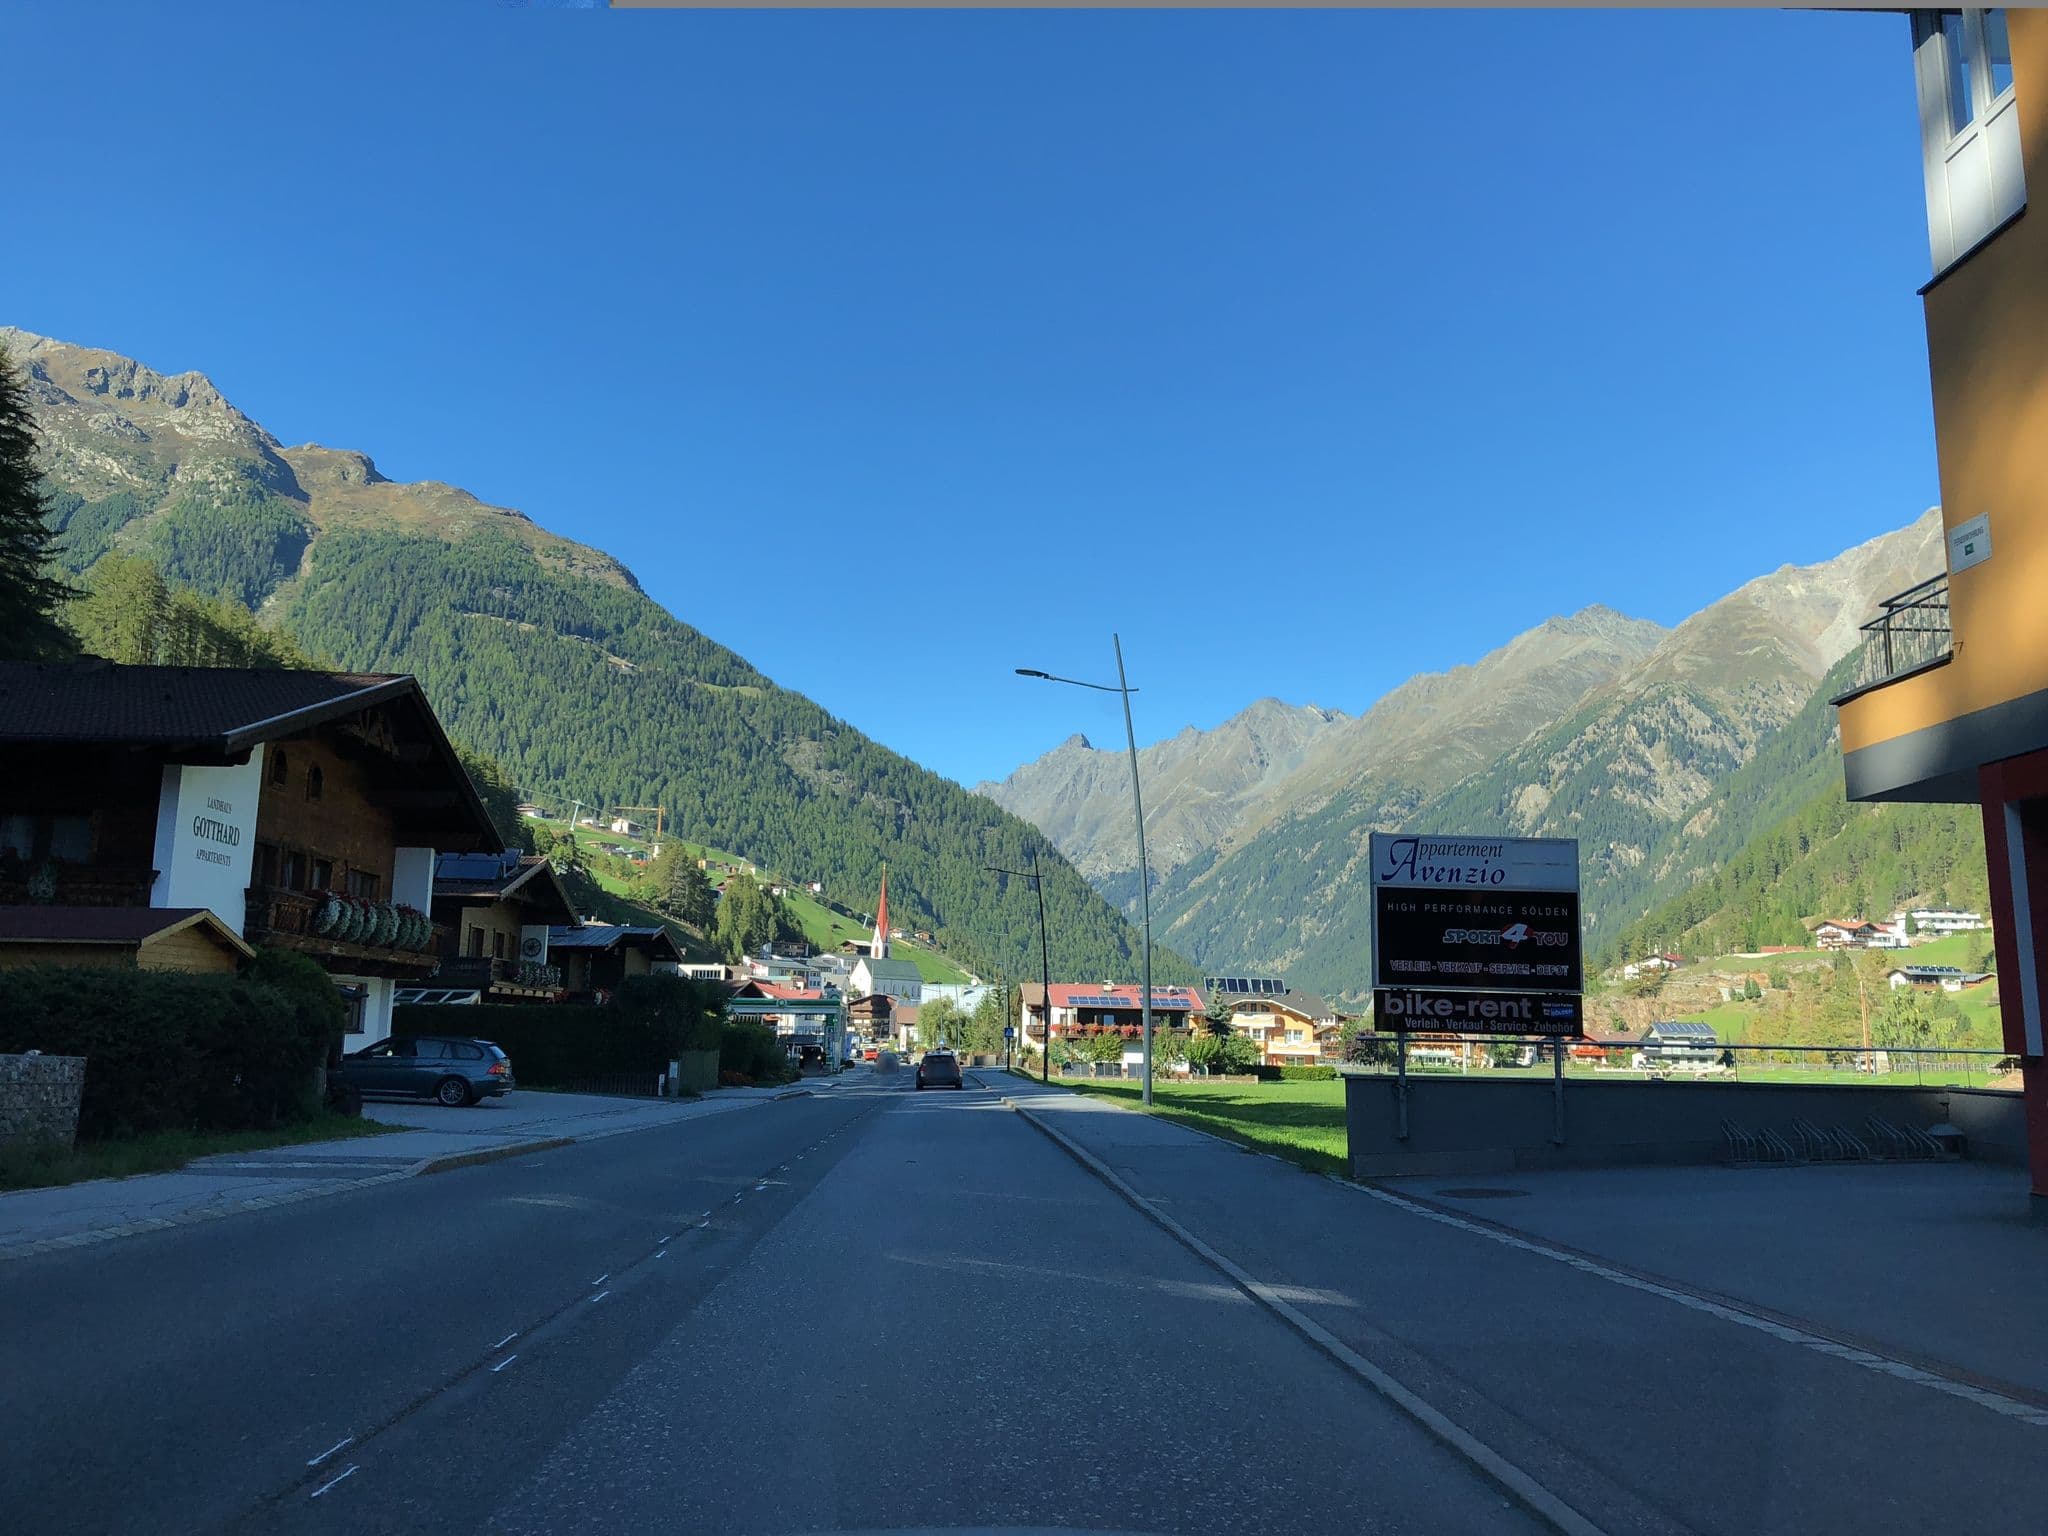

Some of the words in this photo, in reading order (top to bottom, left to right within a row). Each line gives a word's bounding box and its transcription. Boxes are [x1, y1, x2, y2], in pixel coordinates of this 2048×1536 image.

[193, 815, 240, 846] GOTTHARD
[1381, 838, 1506, 884] Avenzio
[1387, 903, 1416, 913] HIGH
[1424, 903, 1513, 915] PERFORMANCE
[1442, 929, 1502, 944] SPORT
[1502, 923, 1529, 943] 4
[1535, 931, 1569, 946] YOU
[1389, 960, 1431, 971] VERLEIH
[1437, 961, 1483, 973] VERKAUF
[1488, 963, 1530, 974] SERVICE
[1536, 964, 1569, 976] DEPOT
[1384, 992, 1532, 1019] bike-rent
[1404, 1017, 1440, 1029] Verleih
[1446, 1018, 1484, 1030] Verkauf
[1490, 1019, 1528, 1031] Service
[1534, 1020, 1575, 1033] Zubehör
